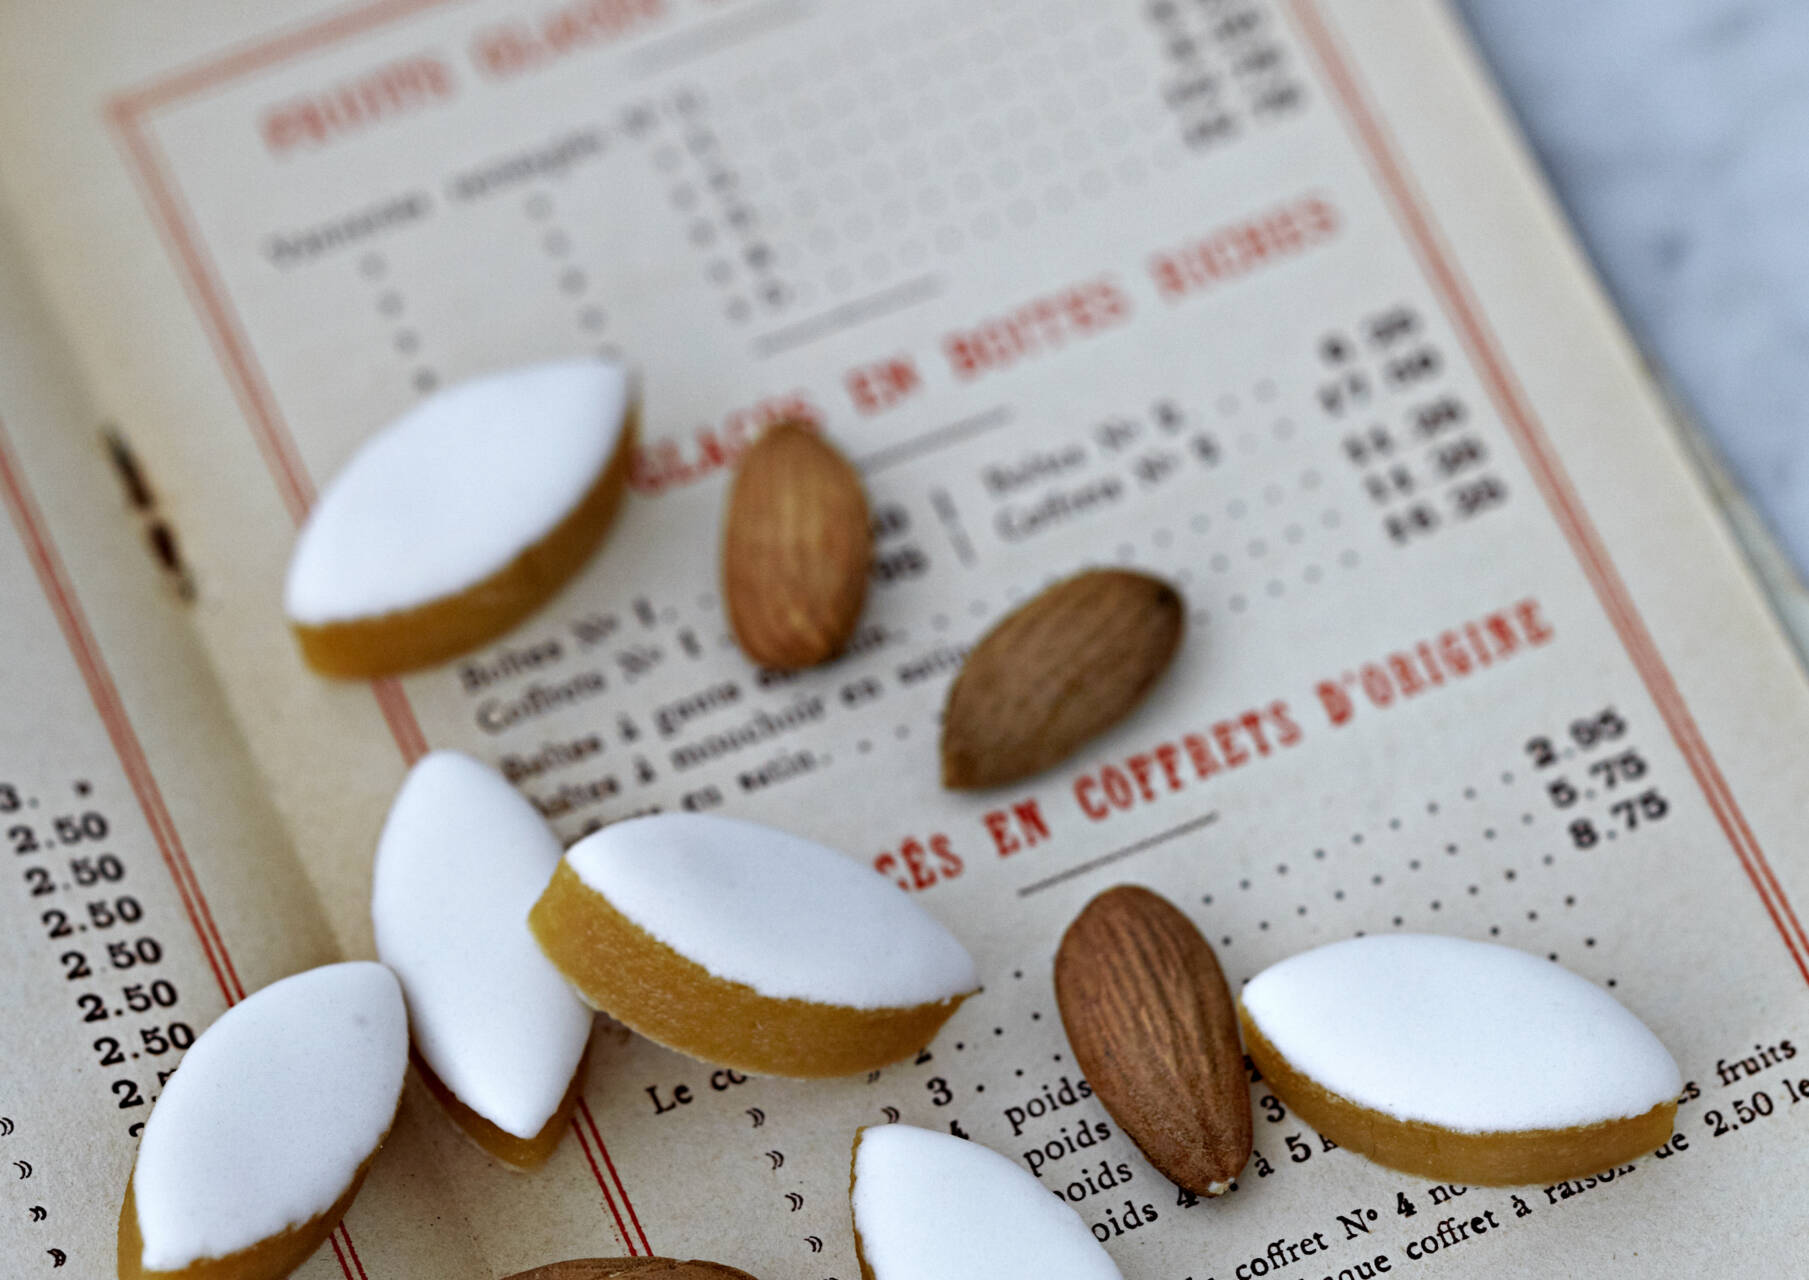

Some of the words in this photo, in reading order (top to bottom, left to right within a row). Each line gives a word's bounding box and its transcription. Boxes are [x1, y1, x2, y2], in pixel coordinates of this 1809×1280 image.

[982, 796, 1052, 859] EN
[1071, 700, 1305, 823] COFFRETS
[1312, 598, 1556, 729] D'ORIGINE
[1547, 747, 1648, 811] 5.75
[8, 810, 108, 855] 2.50
[1568, 788, 1671, 851] 8.75
[24, 854, 125, 898] 2.50
[41, 896, 143, 939] 2.50
[60, 937, 163, 981] 2.50
[76, 979, 178, 1023] 2.50
[93, 1022, 196, 1067] 2.50
[1715, 1039, 1798, 1088] fruits
[645, 1082, 694, 1116] Le
[926, 1076, 953, 1107] 3
[1003, 1076, 1093, 1137] poids
[1259, 1094, 1287, 1124] 3
[1022, 1118, 1112, 1178] poids
[1252, 1149, 1276, 1179] à
[1284, 1132, 1313, 1164] 5
[1405, 1209, 1500, 1261] coffret
[1510, 1194, 1533, 1219] à
[1703, 1090, 1774, 1138] 2.50
[1396, 1190, 1418, 1218] 4
